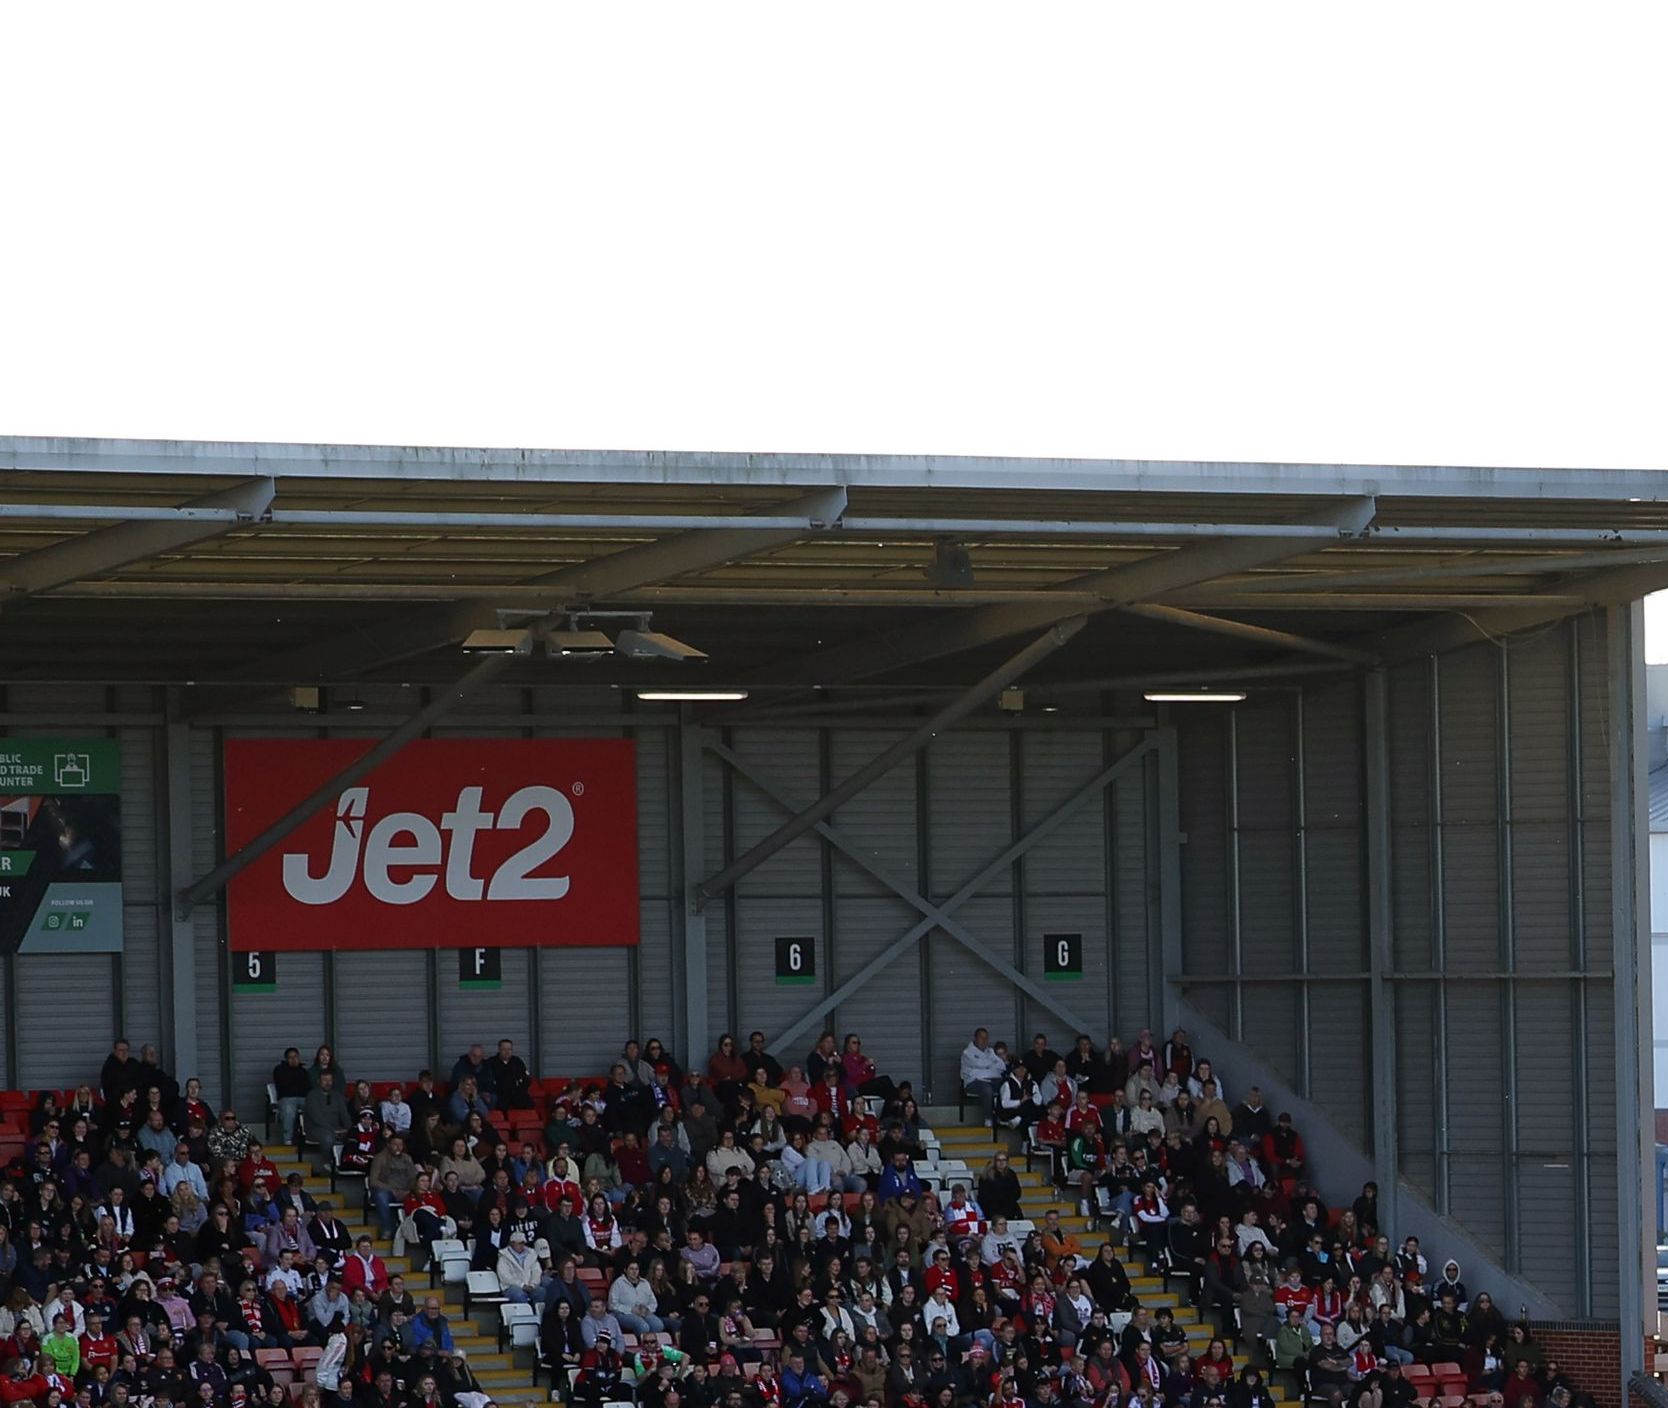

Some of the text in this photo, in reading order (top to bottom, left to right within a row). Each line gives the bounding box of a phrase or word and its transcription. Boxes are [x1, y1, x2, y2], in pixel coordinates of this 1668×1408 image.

[9, 766, 43, 775] TRADE
[282, 785, 575, 905] Jet2
[248, 952, 261, 978] 5
[475, 948, 486, 975] F
[789, 943, 802, 971] 6
[1057, 940, 1069, 967] G
